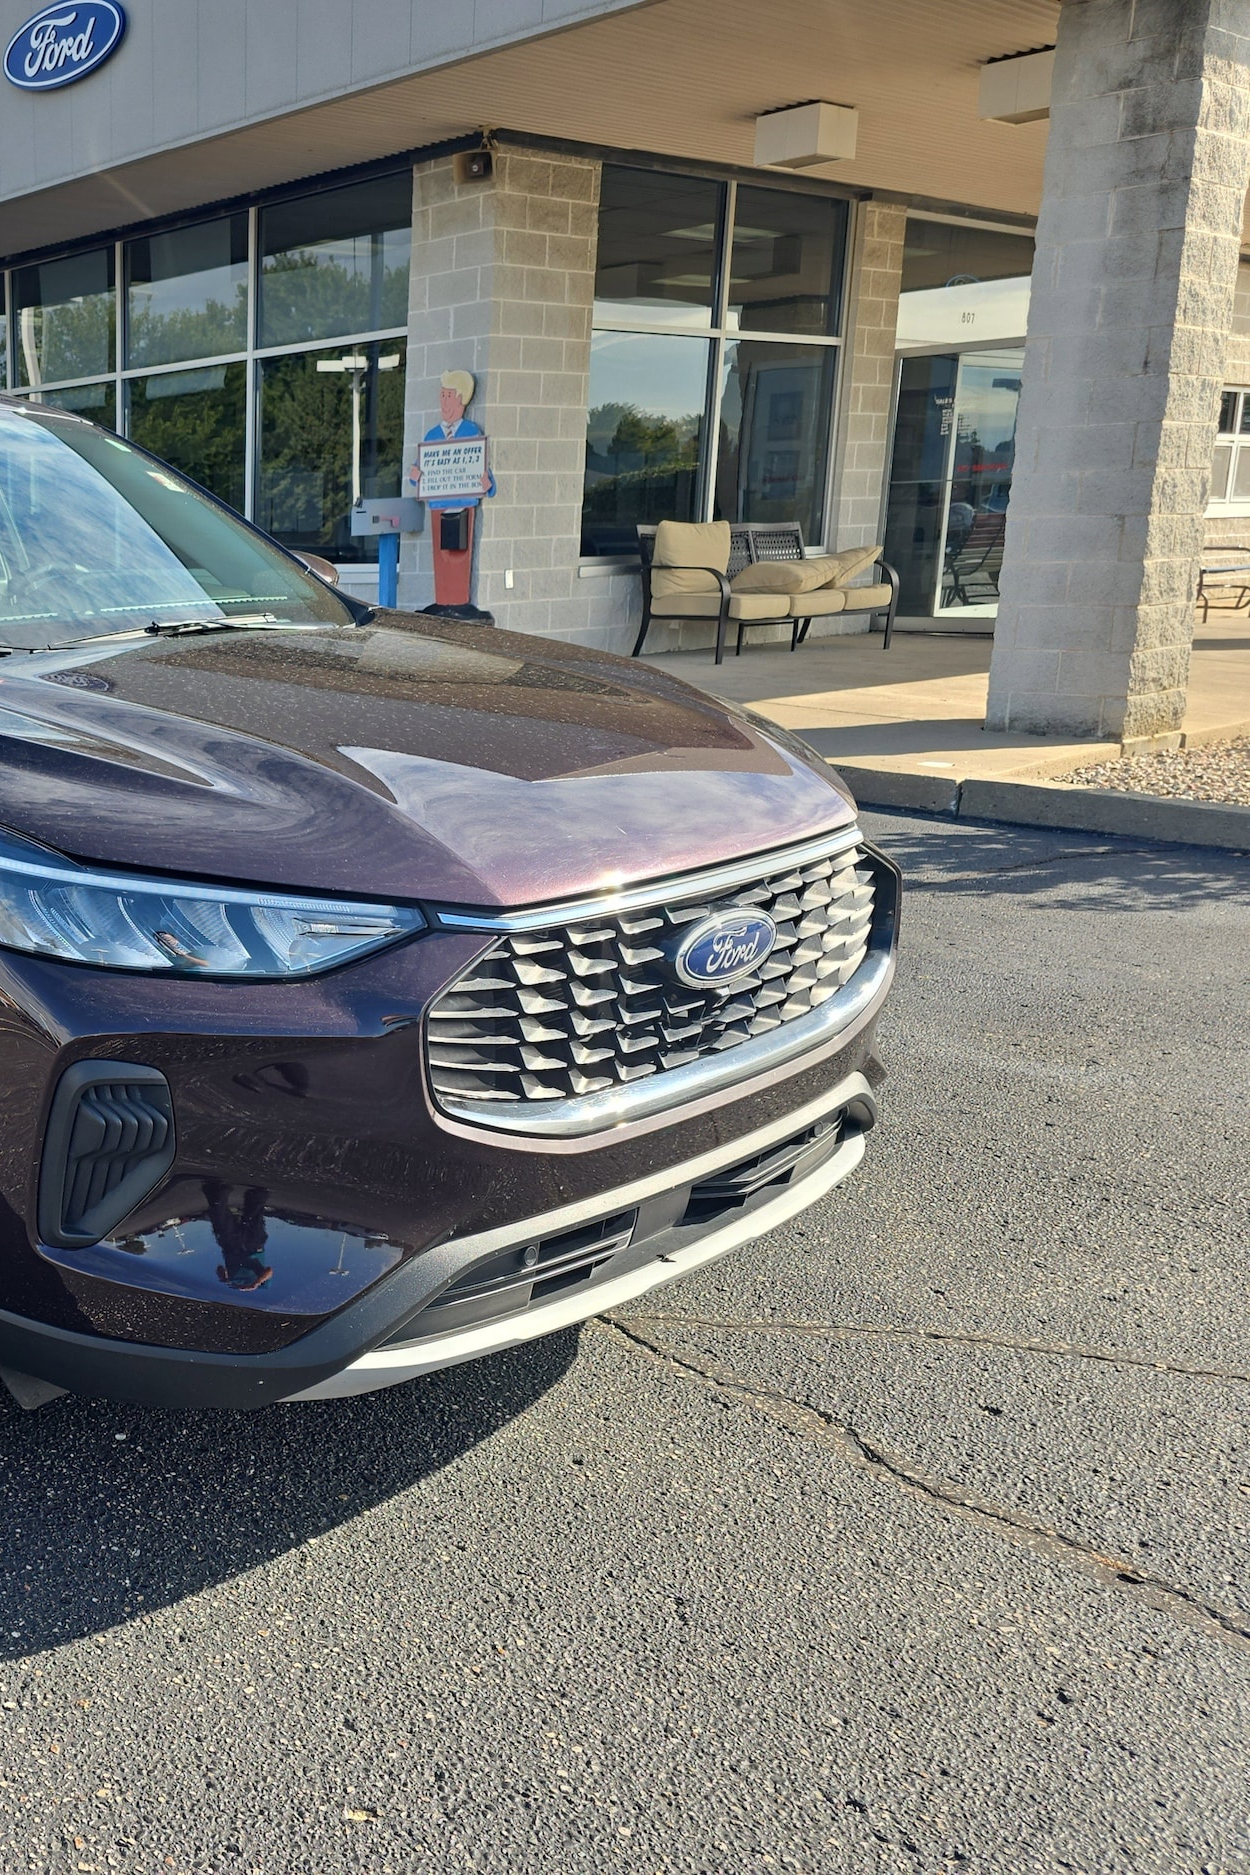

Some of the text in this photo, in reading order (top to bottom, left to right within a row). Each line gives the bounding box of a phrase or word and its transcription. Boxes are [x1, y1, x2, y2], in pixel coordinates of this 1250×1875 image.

[24, 11, 96, 78] Ford
[423, 446, 482, 458] MAKE ME AN OFFER
[423, 459, 435, 467] IT'S
[437, 458, 451, 466] EASY
[706, 926, 760, 973] Ford
